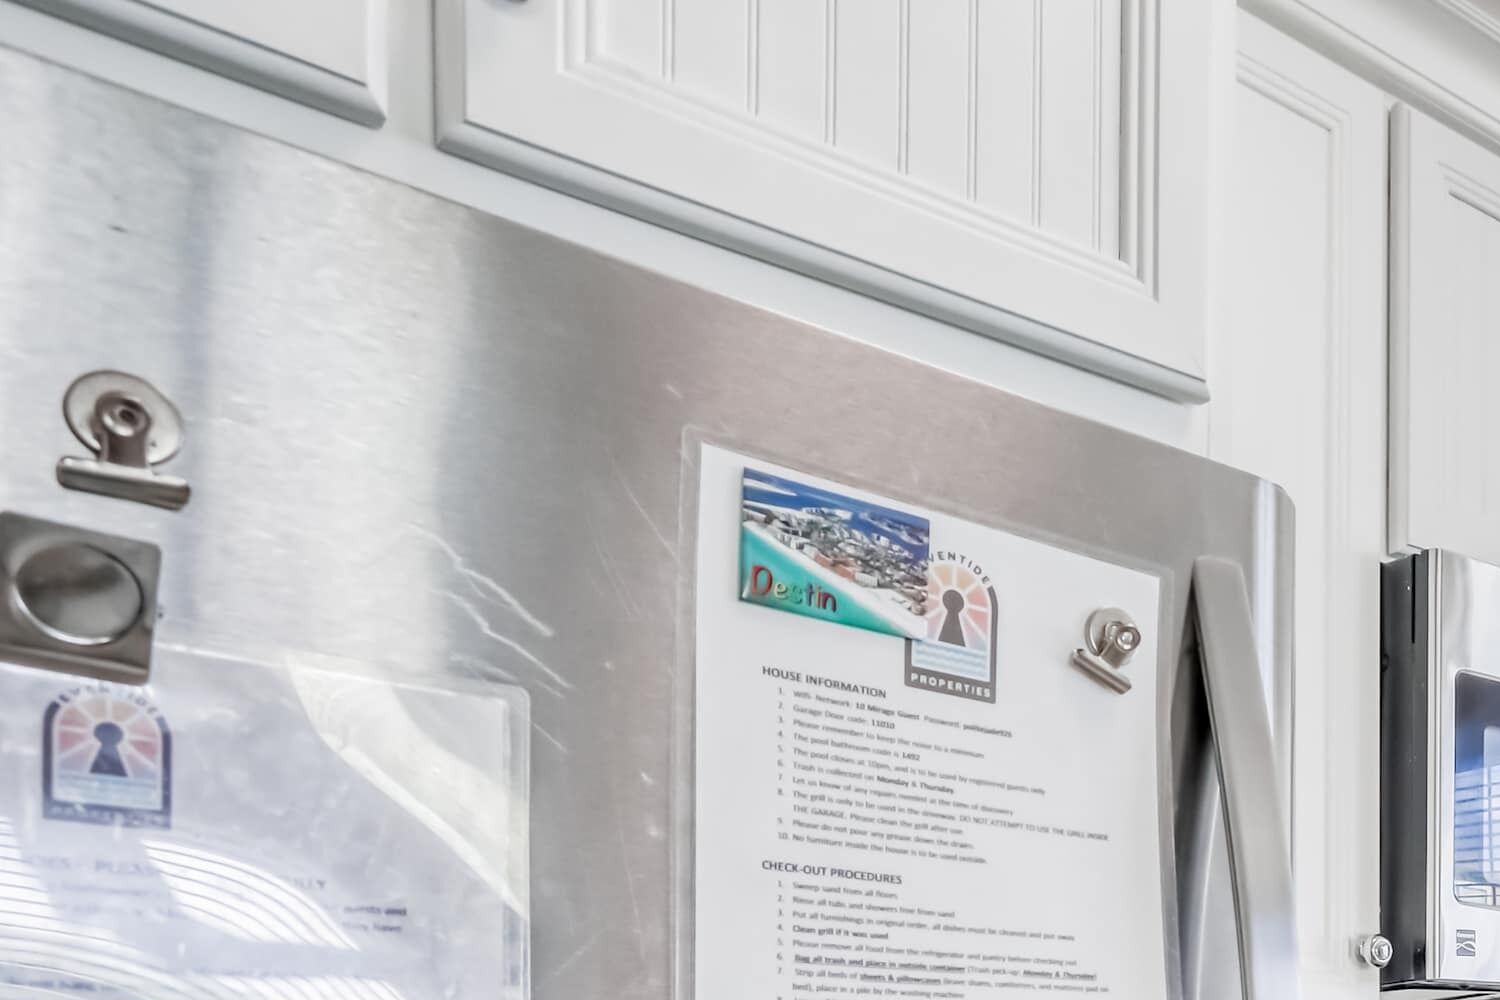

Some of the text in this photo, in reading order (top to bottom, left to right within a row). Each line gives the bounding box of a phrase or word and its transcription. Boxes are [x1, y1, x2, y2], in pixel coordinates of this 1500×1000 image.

[928, 551, 990, 584] VENTIDE
[752, 565, 837, 613] Destin
[762, 665, 886, 699] HOUSE INFORMATION
[911, 672, 991, 698] PROPERTIES
[762, 859, 901, 885] CHECK-OUT PROCEDURES
